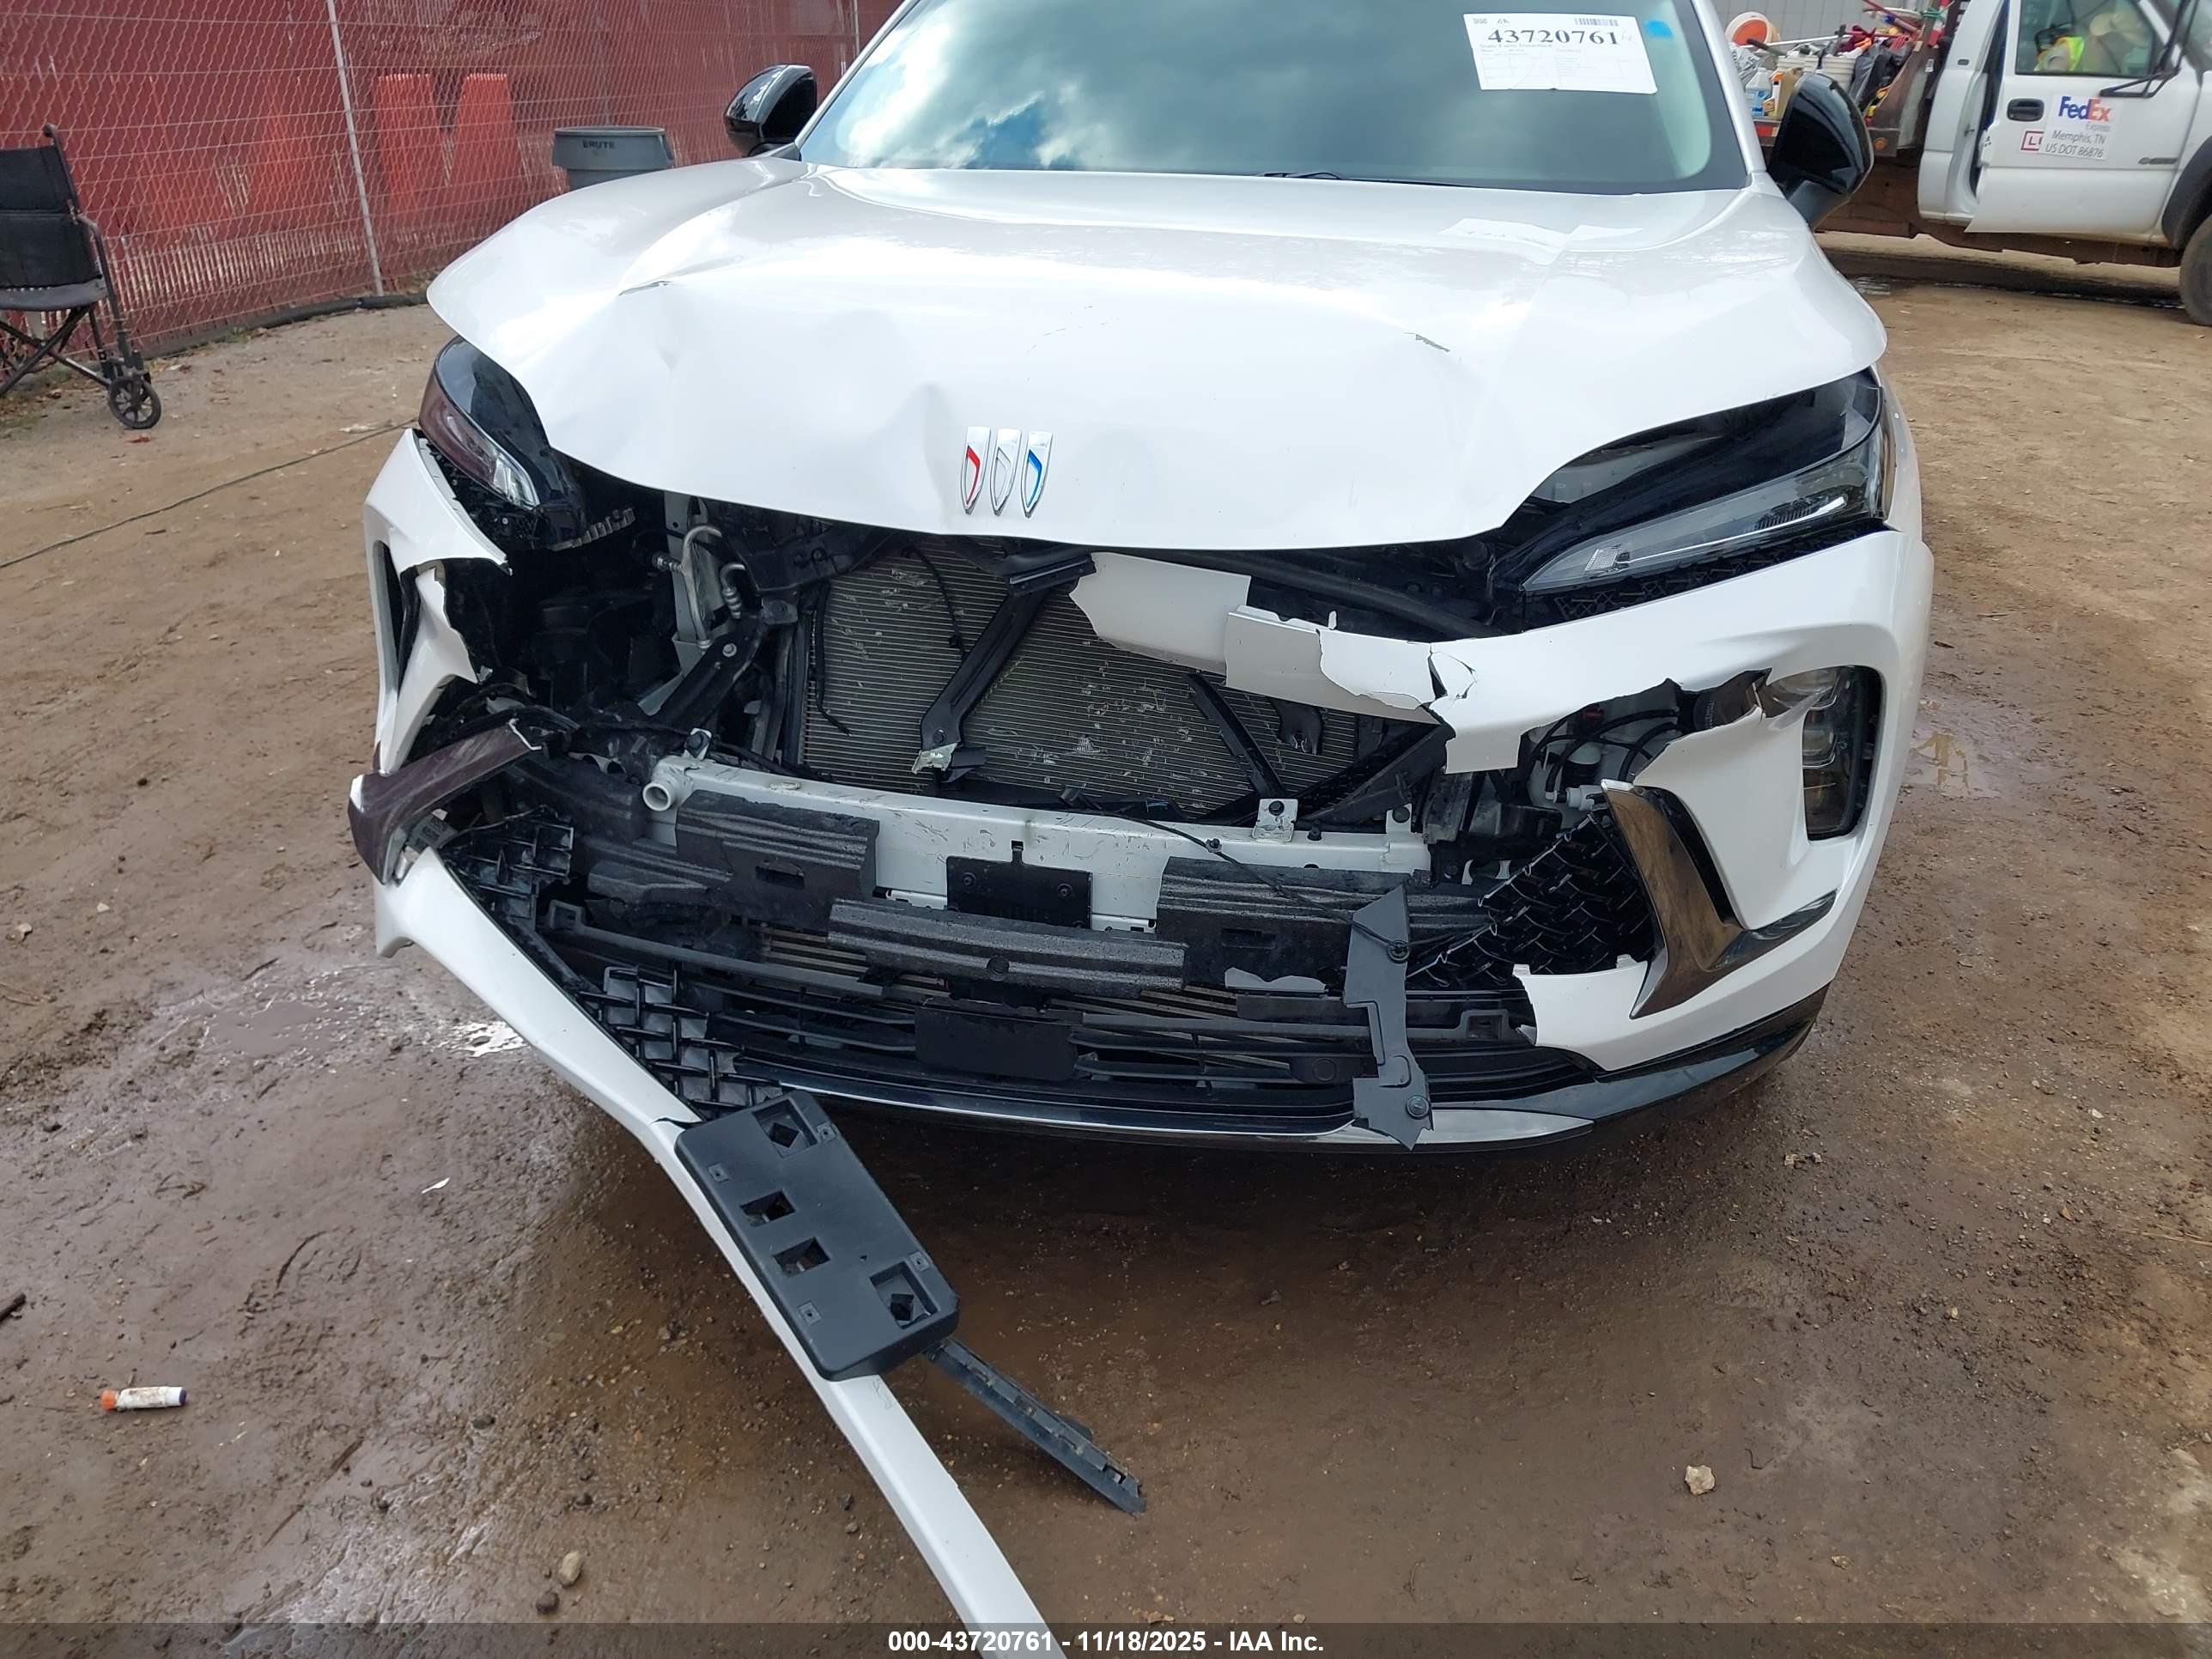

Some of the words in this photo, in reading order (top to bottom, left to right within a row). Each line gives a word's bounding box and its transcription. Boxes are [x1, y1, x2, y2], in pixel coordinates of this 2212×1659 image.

[1487, 29, 1620, 45] 43720761
[2058, 95, 2112, 122] FedEx
[2052, 131, 2091, 143] Memphis,
[2094, 134, 2106, 144] TN
[583, 140, 615, 149] BRUTE
[2045, 143, 2057, 154] US
[2057, 144, 2079, 155] DOT
